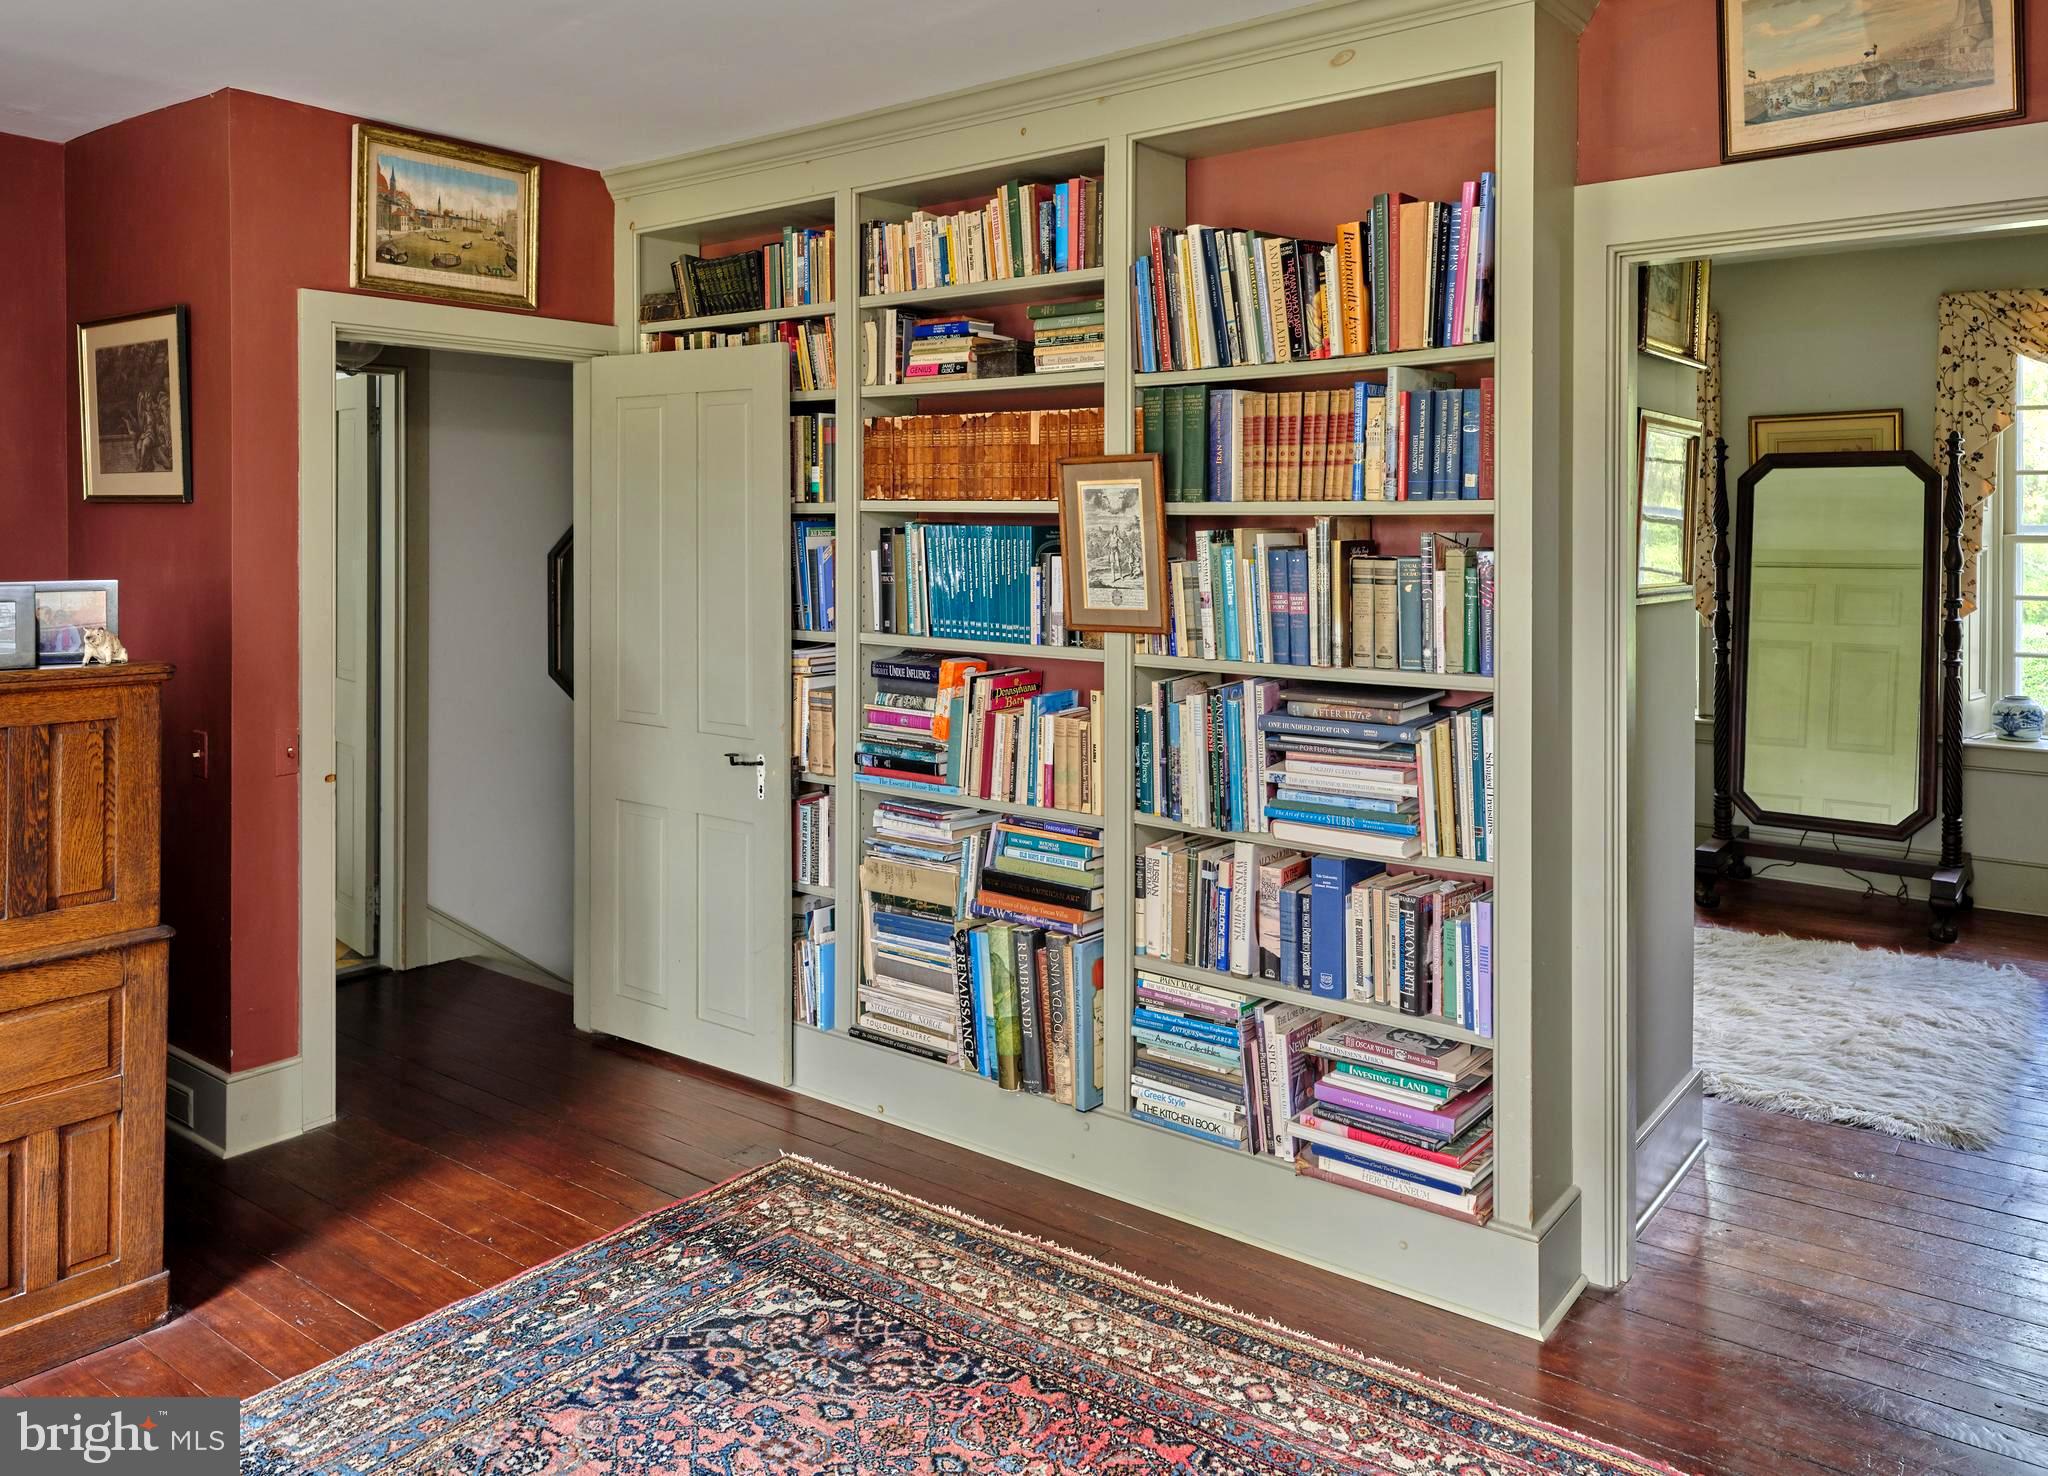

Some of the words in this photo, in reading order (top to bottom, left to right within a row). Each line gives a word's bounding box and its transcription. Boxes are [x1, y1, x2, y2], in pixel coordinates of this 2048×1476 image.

[992, 206, 1001, 241] MYSTERIES
[1376, 222, 1384, 245] LAST
[1449, 207, 1462, 271] MILLER'S
[1269, 243, 1280, 293] ANDREA
[1287, 257, 1295, 273] THE
[1344, 231, 1360, 312] Rembrandt's
[1289, 274, 1298, 292] MAN
[1377, 265, 1385, 303] MILLION
[1291, 294, 1299, 312] WHO
[1447, 293, 1455, 321] Genuine?
[1274, 298, 1287, 358] PALLADIO
[1294, 313, 1302, 338] DARED
[1345, 317, 1361, 346] Eyes
[910, 366, 933, 375] GENIUS
[1216, 444, 1224, 464] IRAN
[1225, 560, 1233, 584] Dutch
[1421, 547, 1433, 602] VIKINGS
[1226, 585, 1234, 606] Tiles
[1480, 580, 1495, 608] 1776
[888, 664, 906, 677] UNDUE
[906, 666, 931, 680] INFLUENCE
[1005, 696, 1025, 708] Barn
[1312, 707, 1342, 719] AFTER
[974, 718, 983, 748] Washington
[1215, 694, 1225, 753] CANALETTO
[1268, 721, 1281, 729] ONE
[1282, 722, 1312, 732] HUNDRED
[1313, 725, 1333, 733] GREAT
[1333, 726, 1350, 735] GUNS
[1299, 744, 1337, 755] PORTUGAL
[1471, 717, 1480, 762] VERSAILLES
[1485, 752, 1494, 790] Salvaged
[1326, 815, 1356, 828] STUBBS
[1486, 793, 1494, 835] Treasures
[1151, 858, 1160, 897] RUSSIAN
[1234, 861, 1244, 894] WINES
[982, 905, 1005, 918] LAW
[1218, 890, 1226, 935] HERBLOCK
[1233, 903, 1243, 941] SPIRITS
[1355, 918, 1363, 927] THE
[1400, 908, 1415, 941] FURY
[1302, 928, 1312, 944] Beirut
[1355, 927, 1364, 957] CHANCELLOR
[1405, 940, 1415, 957] ON
[1049, 949, 1061, 986] VINCI
[1299, 951, 1312, 976] Jerusalem
[1355, 957, 1364, 987] MANUSCRIPT
[1017, 943, 1033, 1037] REMBRANDT
[1041, 965, 1052, 1019] UNKNOWN
[1159, 976, 1179, 987] PAINT
[1181, 981, 1201, 992] MAGIC
[1400, 960, 1415, 997] EARTH
[957, 953, 974, 1057] RENAISSANCE
[1052, 989, 1062, 1007] DA
[866, 1018, 931, 1042] TOULOUSE-LAUTREC
[918, 1016, 943, 1030] NORGE
[1045, 1022, 1055, 1076] LEONARDO
[1154, 1034, 1184, 1048] American
[1184, 1040, 1220, 1057] Collectibles
[1289, 1040, 1306, 1054] NEW
[1355, 1040, 1375, 1051] OSCAR
[1375, 1044, 1394, 1056] WILDE
[1259, 1052, 1267, 1077] Picture
[1267, 1044, 1278, 1083] SPICES
[1362, 1054, 1385, 1065] AFRICA
[1260, 1078, 1270, 1105] Framing
[1349, 1065, 1391, 1084] INVESTING
[1392, 1079, 1399, 1087] in
[1399, 1077, 1429, 1094] LAND
[1143, 1089, 1167, 1102] Greek
[1167, 1095, 1186, 1108] Style
[1142, 1102, 1158, 1115] THE
[1159, 1106, 1194, 1126] KITCHEN
[1195, 1118, 1221, 1134] BOOK
[1377, 1139, 1395, 1152] The
[1398, 1146, 1432, 1161] Roses
[1361, 1173, 1431, 1200] HERCULANEUM
